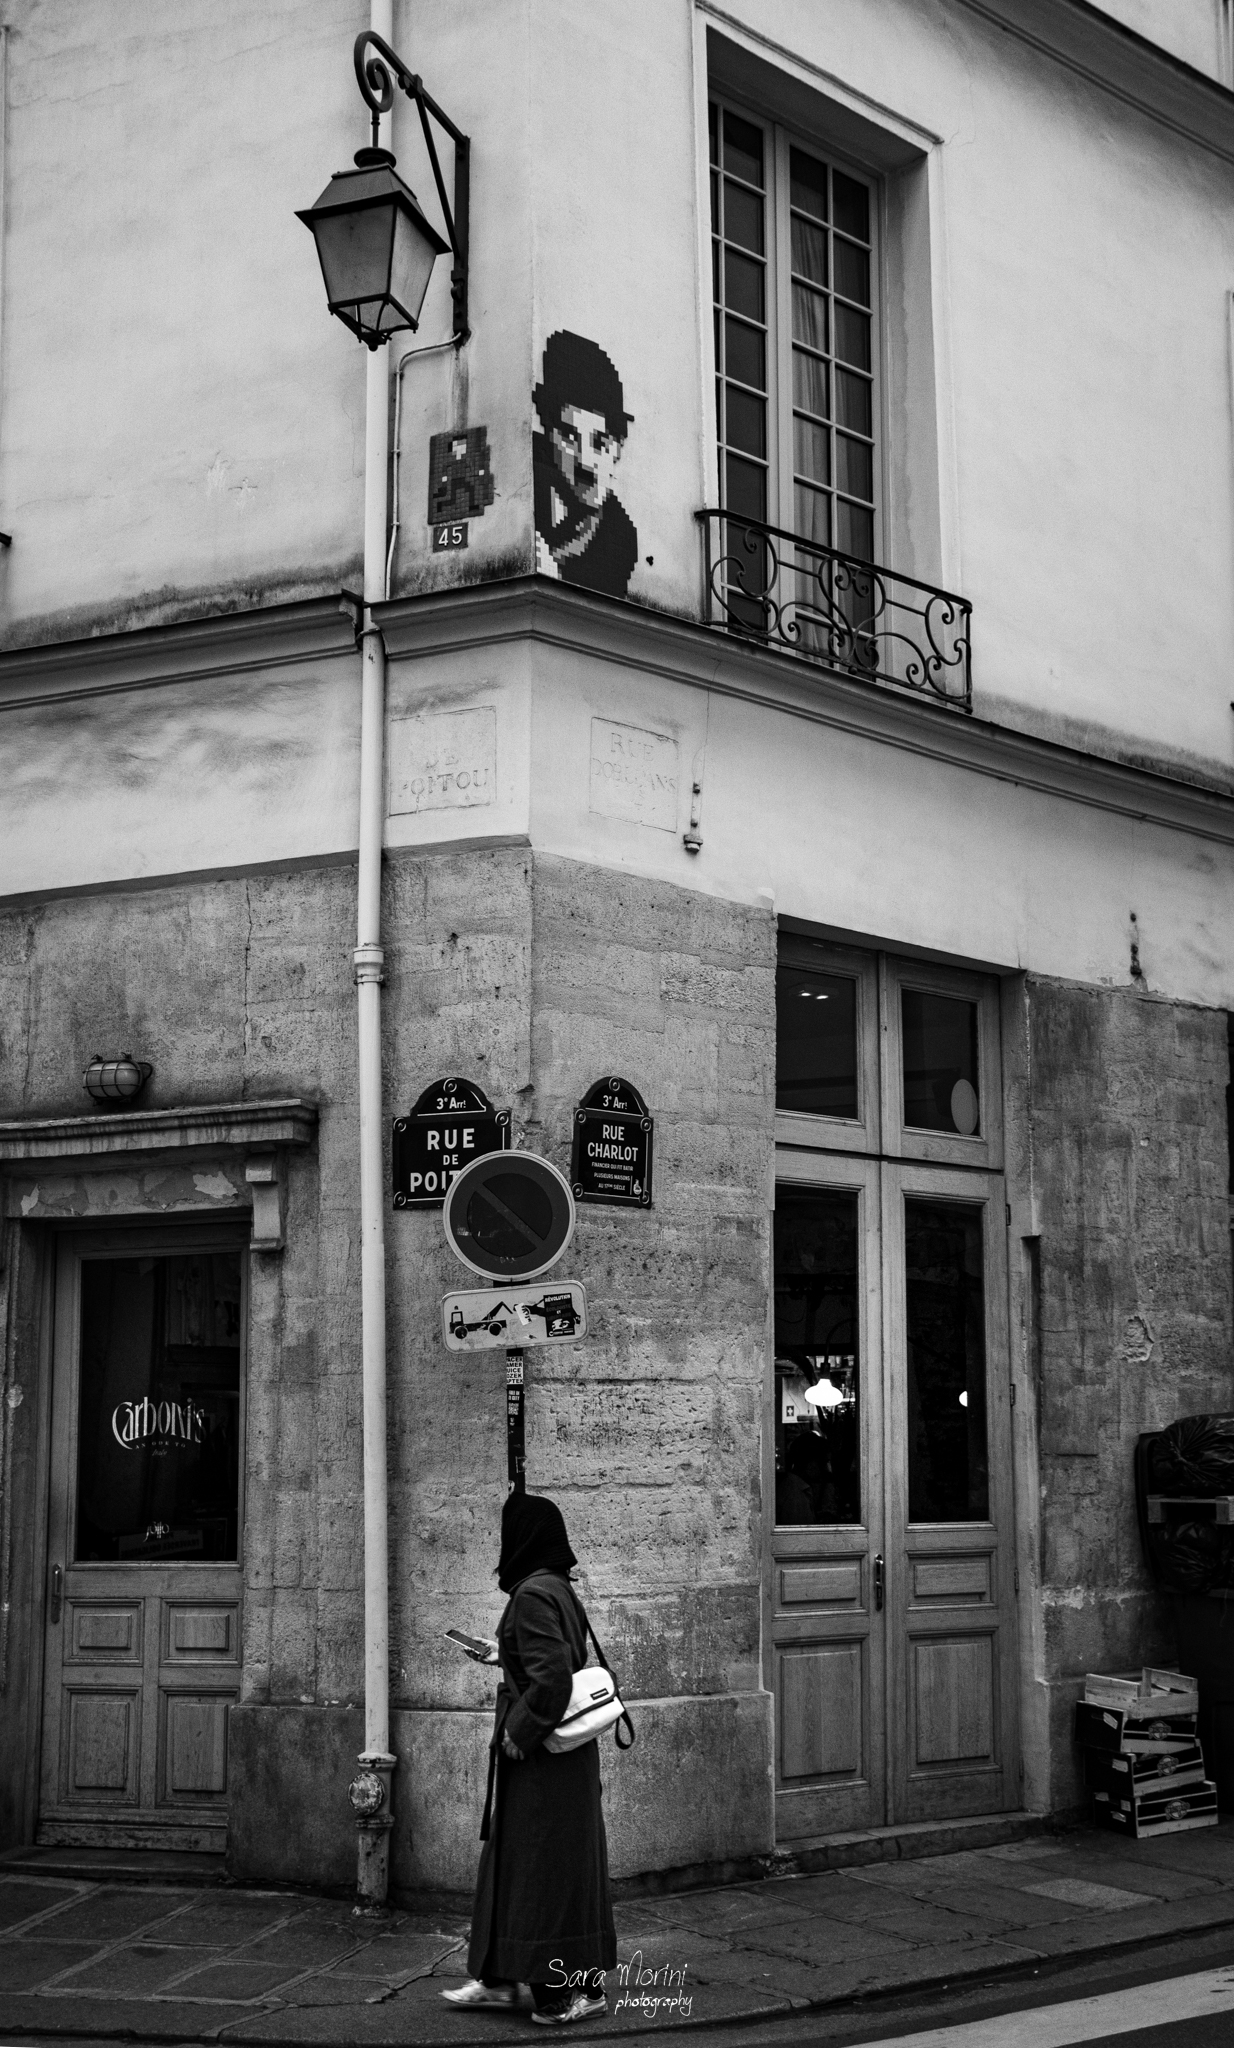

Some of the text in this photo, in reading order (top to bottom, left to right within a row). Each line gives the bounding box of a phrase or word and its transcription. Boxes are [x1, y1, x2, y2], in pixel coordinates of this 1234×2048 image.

[438, 526, 463, 546] 45
[398, 768, 490, 798] OITOU
[427, 1128, 475, 1151] RUE
[602, 1124, 625, 1141] RUE
[442, 1154, 459, 1166] DE
[587, 1142, 639, 1162] CHARLOT
[591, 1161, 610, 1169] FINANCIER
[111, 1396, 207, 1450] Carboni's
